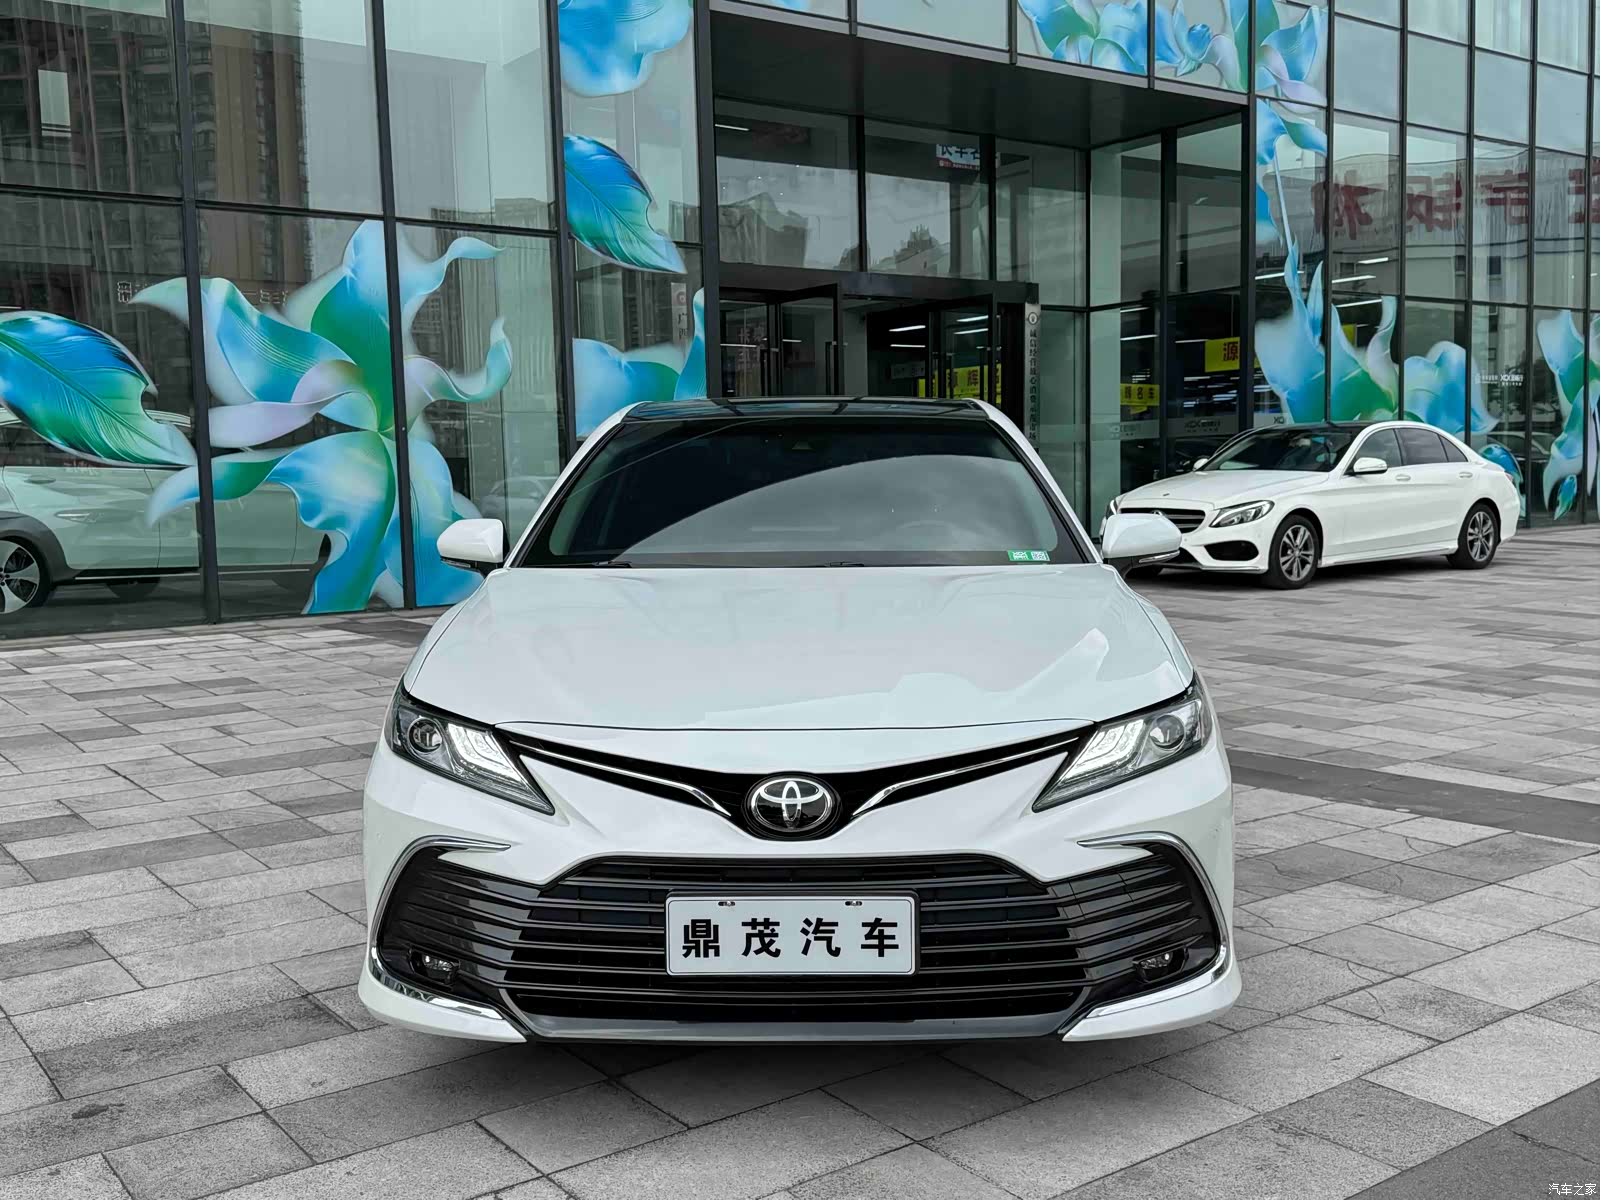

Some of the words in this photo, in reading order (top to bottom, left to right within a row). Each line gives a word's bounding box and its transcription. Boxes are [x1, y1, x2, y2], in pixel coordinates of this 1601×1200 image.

[1223, 341, 1239, 361] 源
[682, 917, 900, 958] 鼎茂汽车
